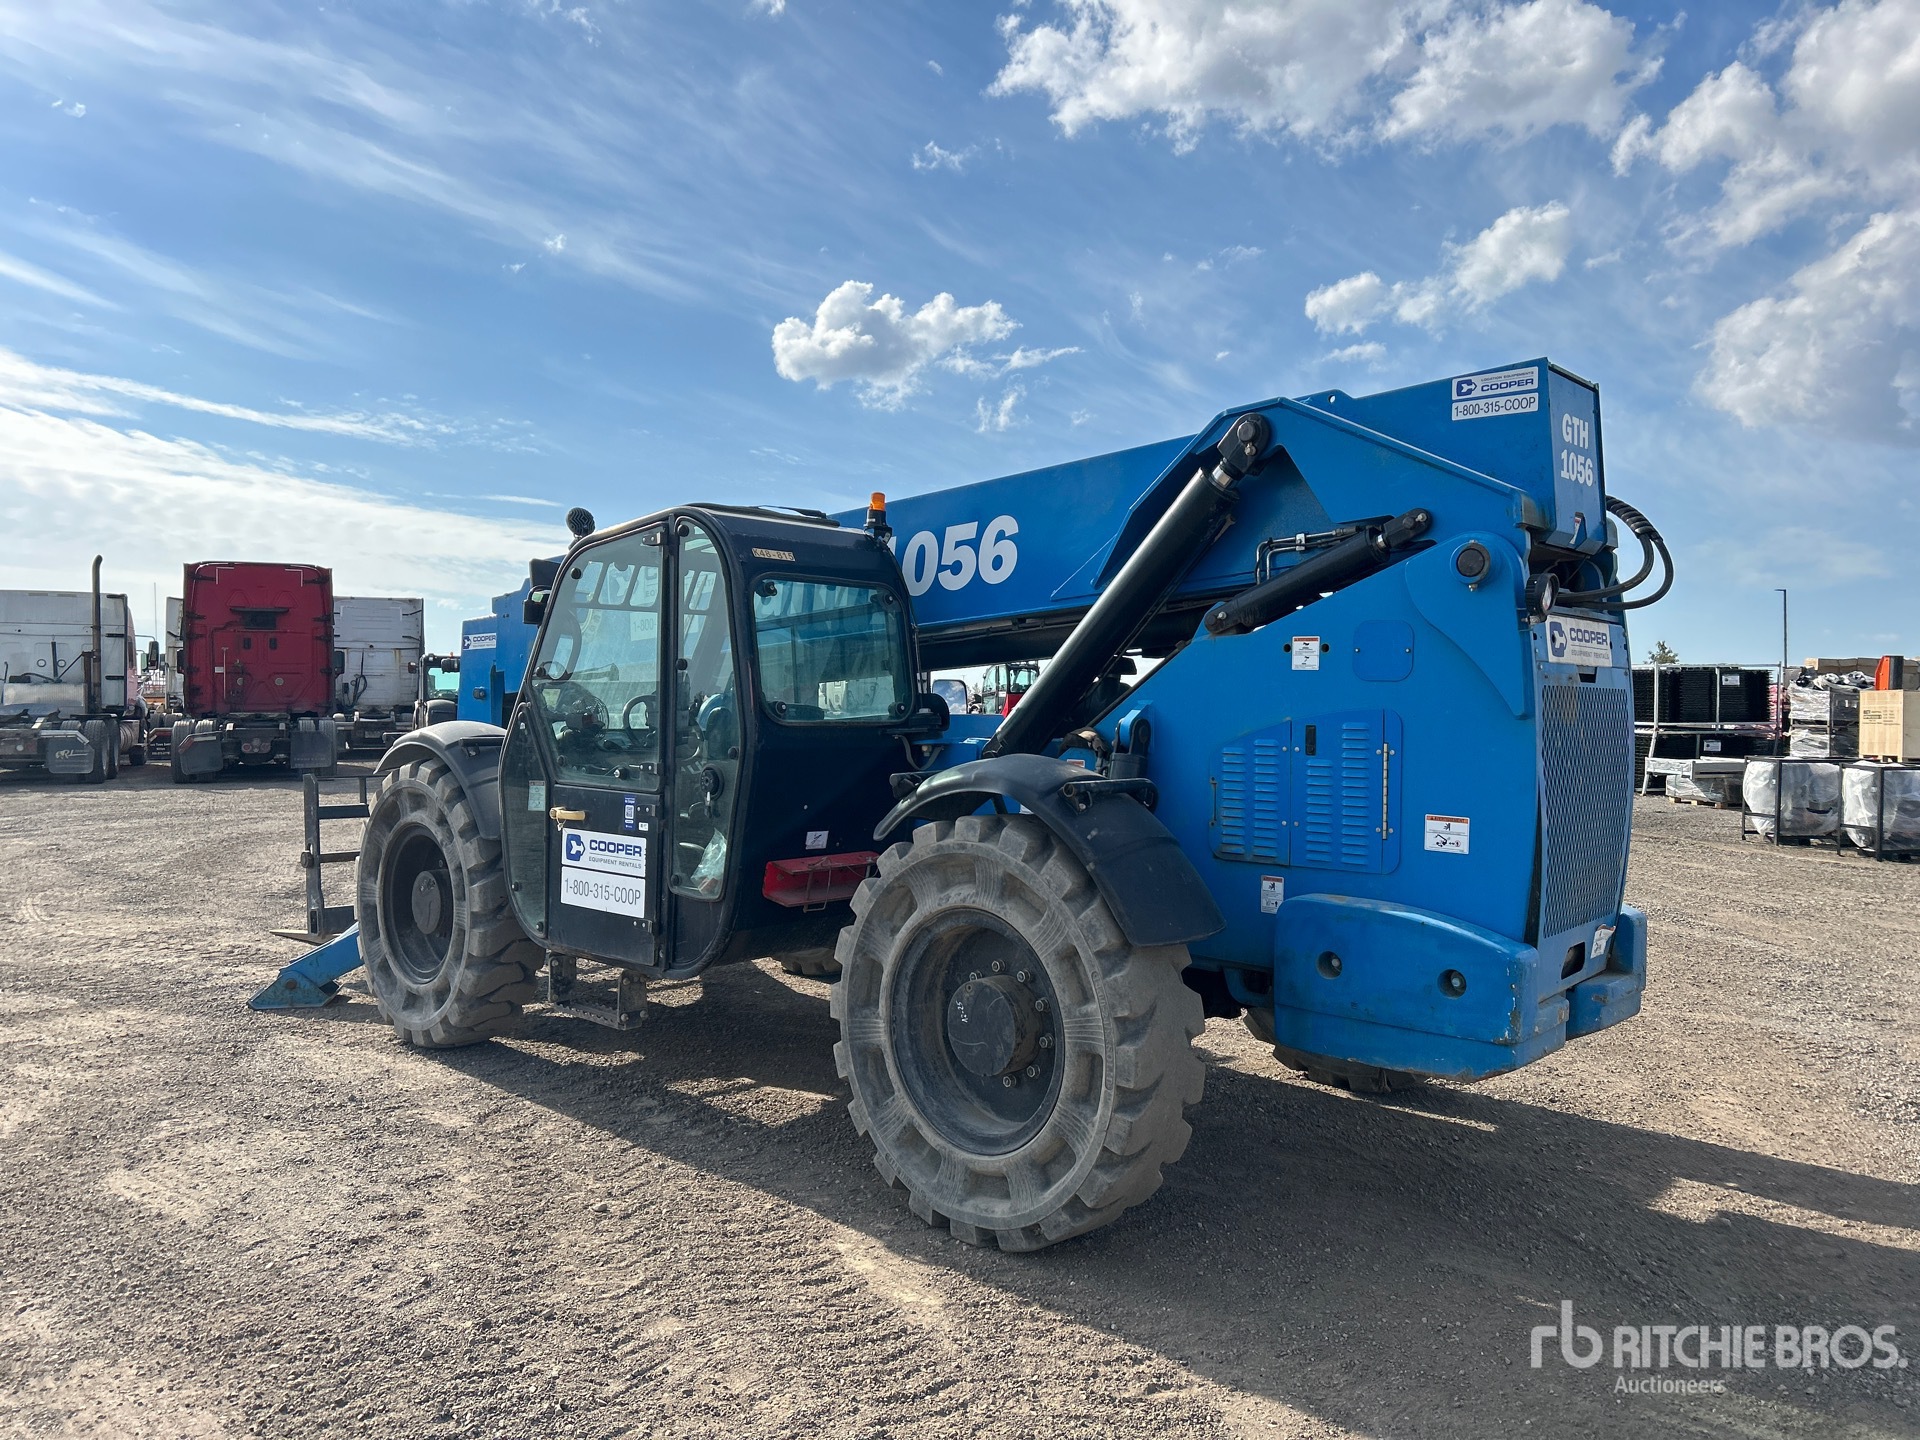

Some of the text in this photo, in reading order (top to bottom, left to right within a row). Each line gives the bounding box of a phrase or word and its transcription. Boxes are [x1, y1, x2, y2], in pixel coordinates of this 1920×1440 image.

[1481, 378, 1534, 392] COOPER
[1454, 396, 1536, 417] 1-800-315-COOP
[1562, 413, 1589, 450] GTH
[1560, 449, 1593, 487] 1056
[752, 548, 794, 560] K48-815
[472, 635, 497, 643] COOPER
[1570, 628, 1608, 645] COOPER
[590, 839, 642, 857] COOPER
[589, 857, 641, 869] EQUIPMENT RENTALS
[564, 877, 641, 906] 1-800-315-COOP
